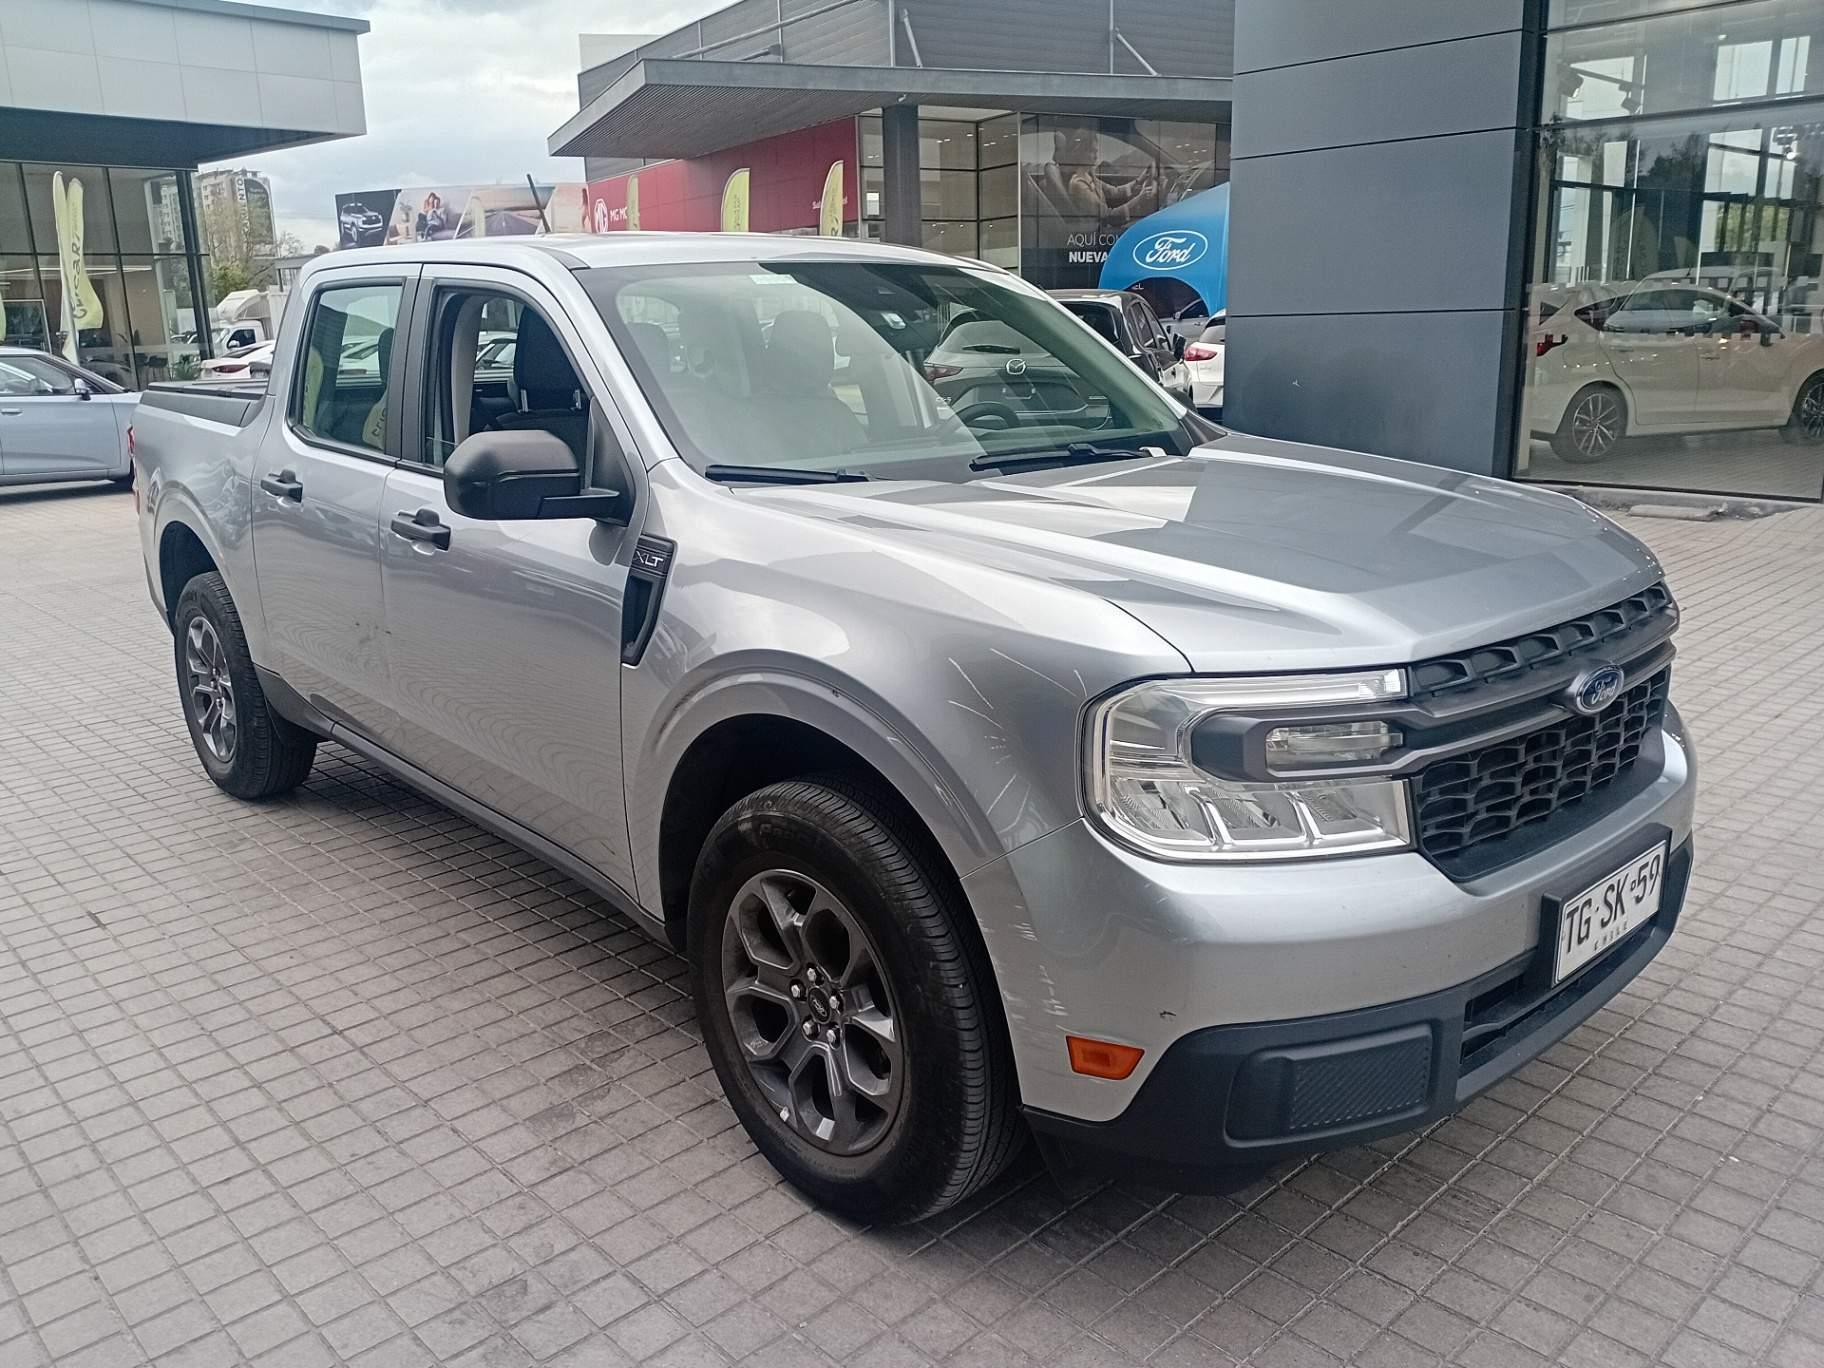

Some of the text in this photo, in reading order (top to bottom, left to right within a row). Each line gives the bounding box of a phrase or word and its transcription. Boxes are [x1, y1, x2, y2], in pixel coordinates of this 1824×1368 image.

[1068, 251, 1109, 263] NUEVA
[1145, 236, 1196, 263] Ford
[633, 550, 664, 567] XLT
[1591, 675, 1618, 705] Ford
